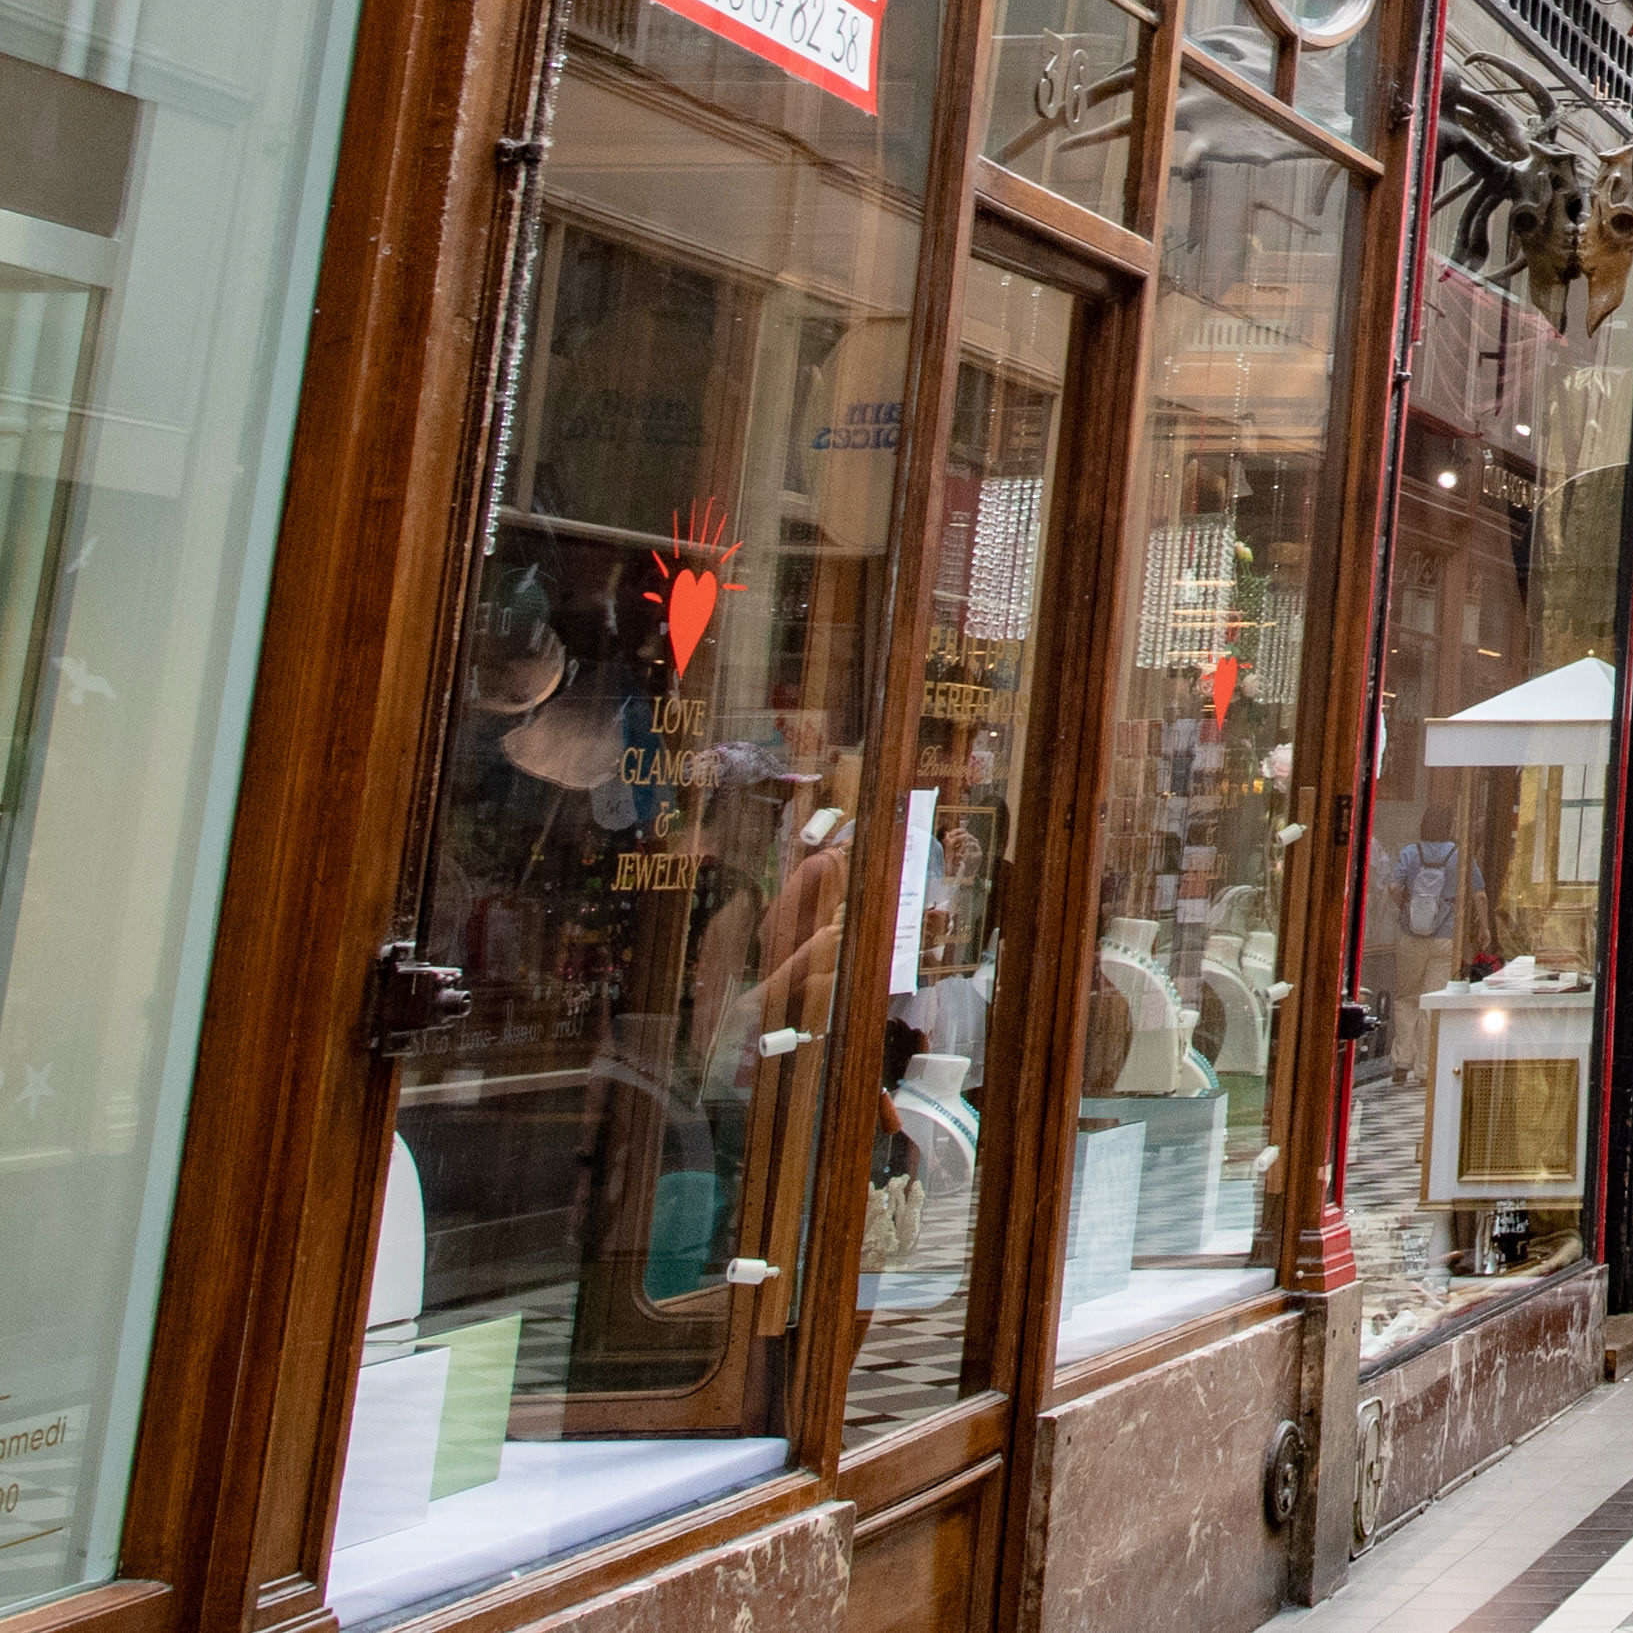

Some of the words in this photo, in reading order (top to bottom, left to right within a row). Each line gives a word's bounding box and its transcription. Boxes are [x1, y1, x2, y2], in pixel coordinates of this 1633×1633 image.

[651, 696, 707, 736] LOVE
[621, 747, 720, 788] GLAMOUR
[655, 801, 681, 838] &
[611, 852, 705, 892] JEWELRY
